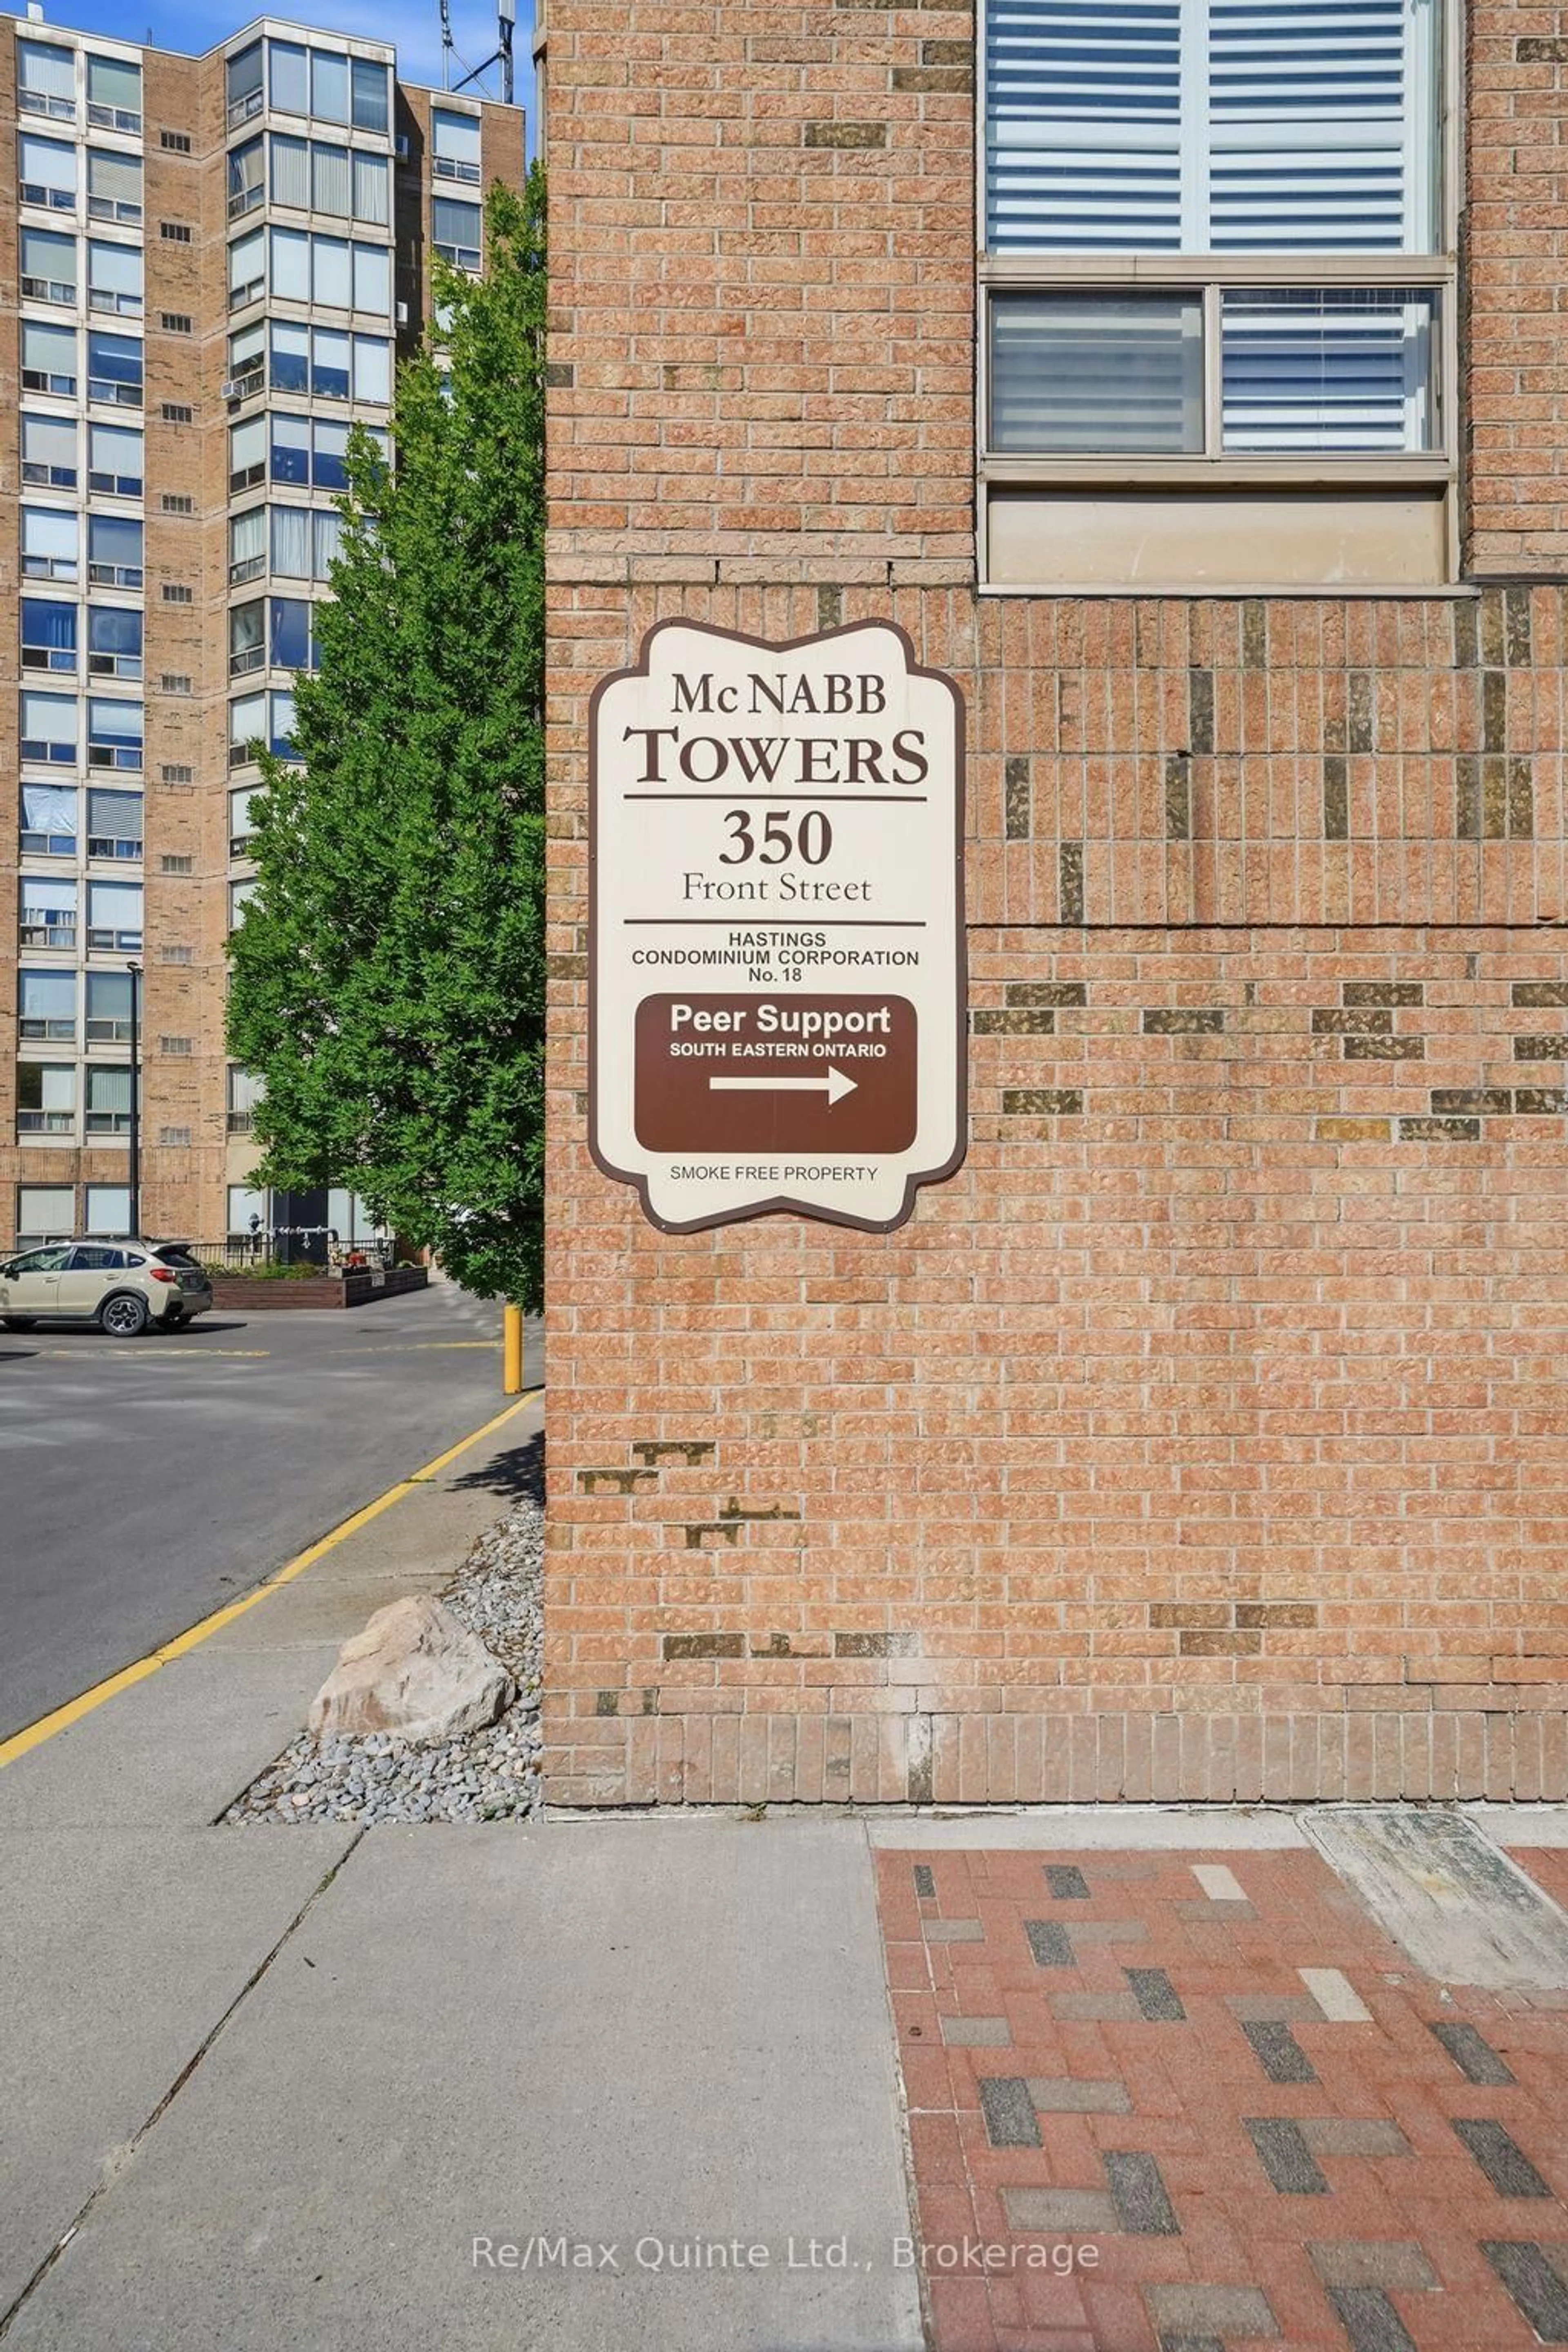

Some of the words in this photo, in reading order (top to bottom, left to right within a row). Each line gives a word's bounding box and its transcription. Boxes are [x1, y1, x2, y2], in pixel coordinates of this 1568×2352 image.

[622, 726, 929, 785] TOWERS
[719, 810, 833, 865] 350
[683, 873, 768, 900] Front
[779, 873, 872, 901] Street
[729, 932, 826, 947] HASTINGS
[632, 950, 771, 965] CONDOMINIUM
[778, 950, 919, 966] CORPORATION
[749, 967, 778, 982] No.
[782, 967, 802, 982] 18
[671, 1004, 746, 1032] Peer
[757, 1004, 891, 1039] Support
[670, 1042, 726, 1056] SOUTH
[732, 1043, 809, 1057] EASTERN
[813, 1043, 886, 1058] ONTARIO
[670, 1165, 731, 1180] SMOKE
[735, 1166, 780, 1180] FREE
[784, 1166, 878, 1181] PROPERTY
